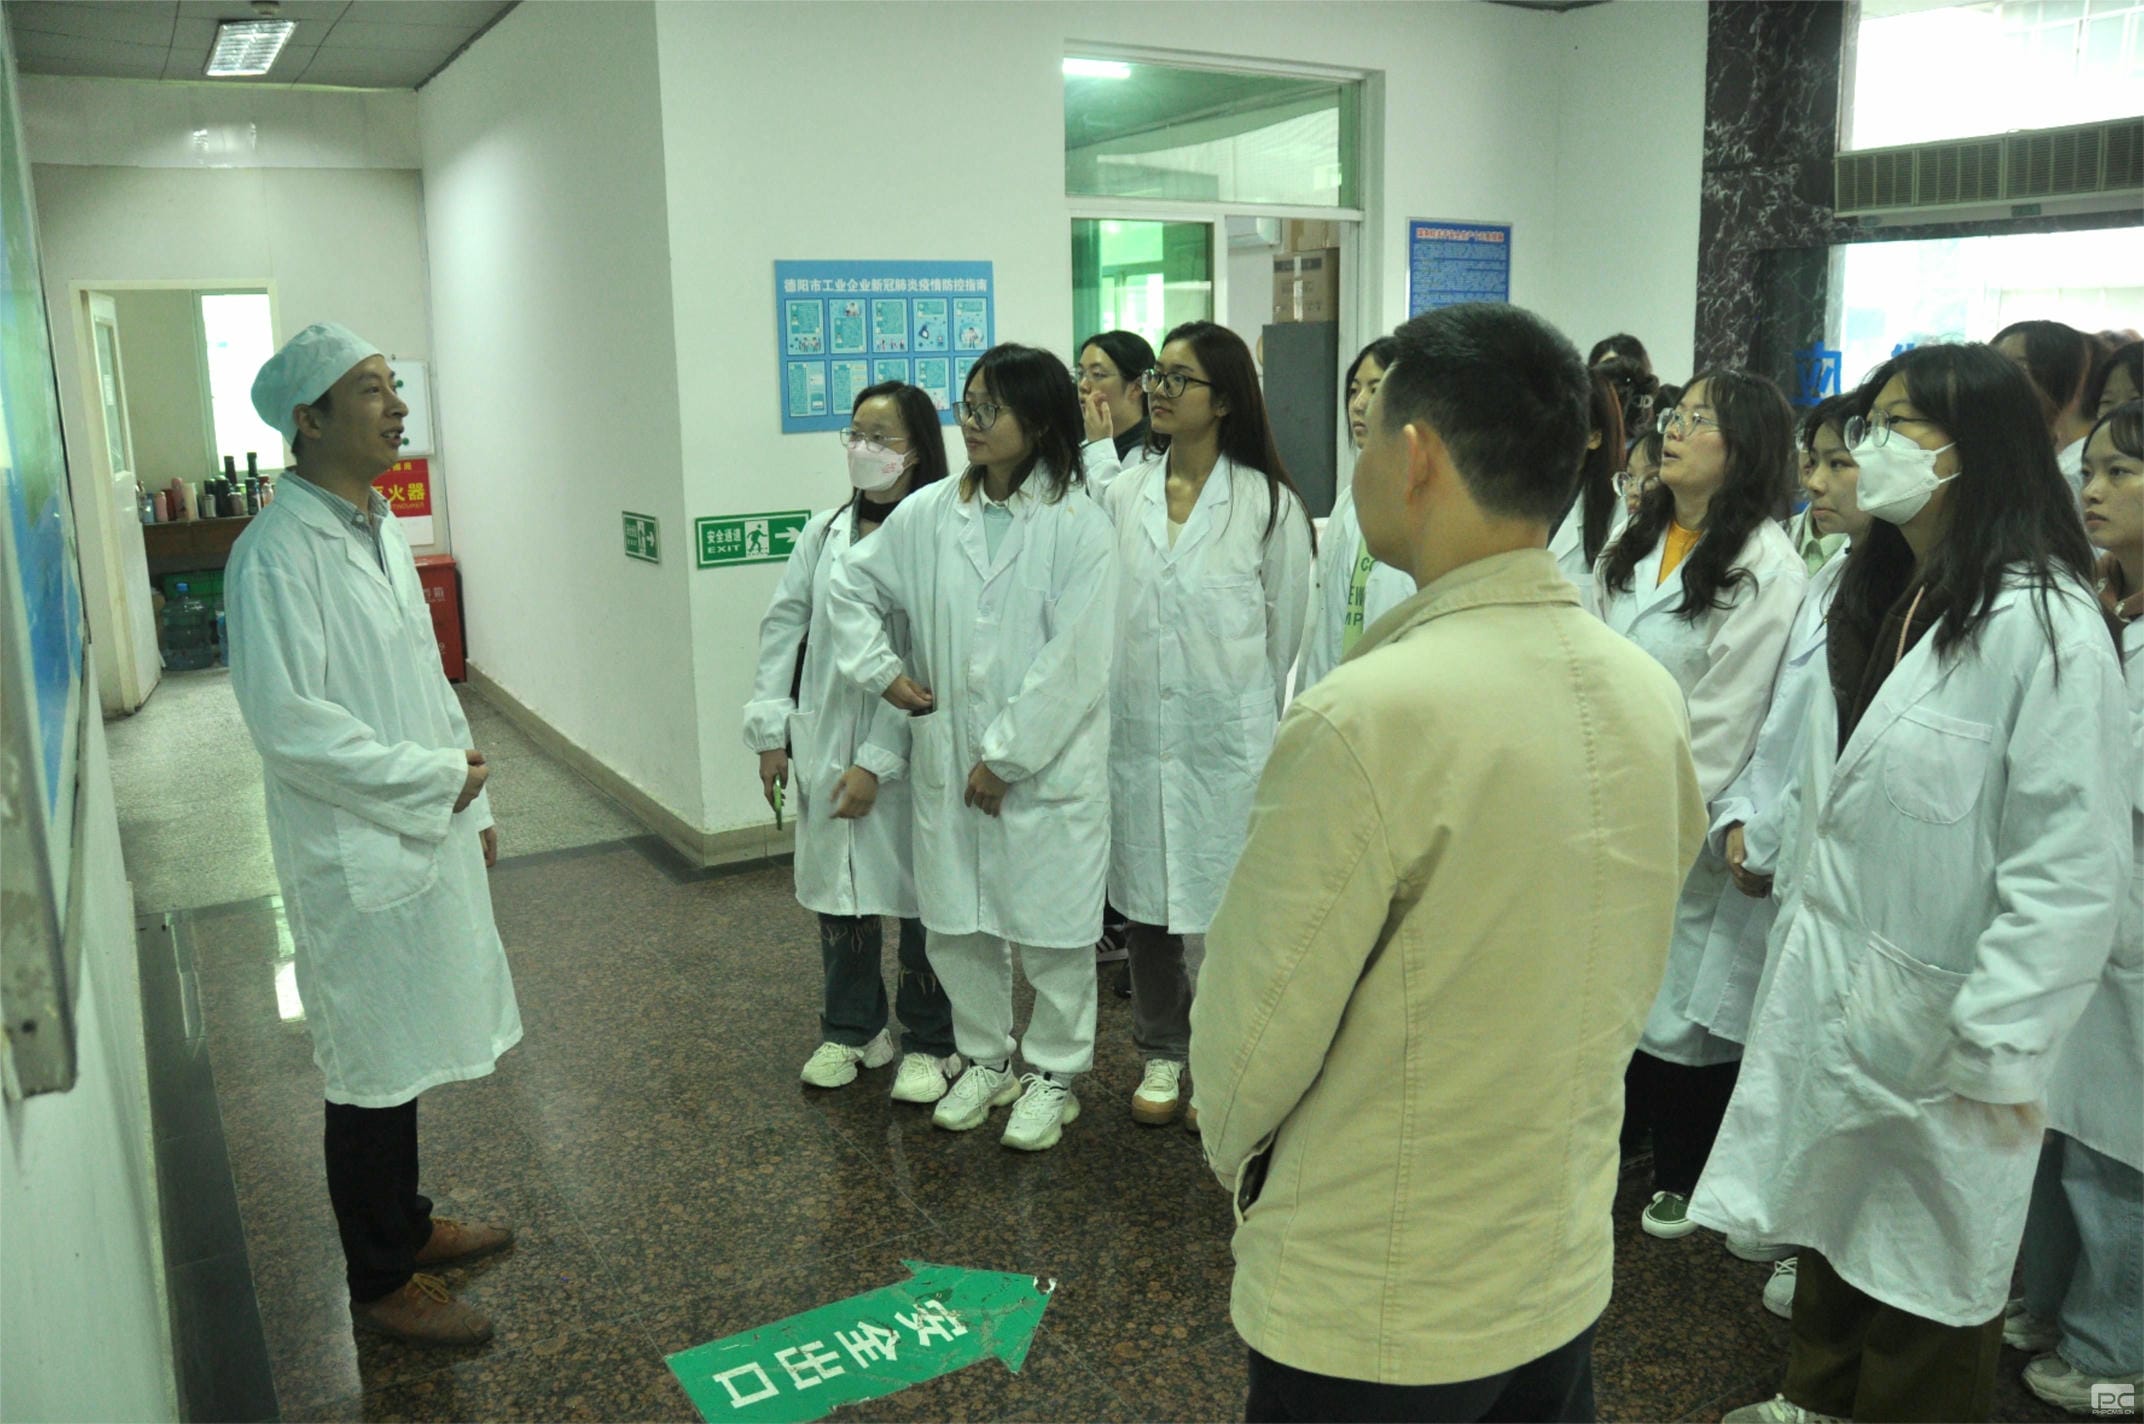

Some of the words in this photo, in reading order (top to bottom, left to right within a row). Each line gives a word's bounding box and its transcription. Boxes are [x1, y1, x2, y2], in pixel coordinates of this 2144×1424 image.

[707, 528, 741, 544] 安全通道
[708, 544, 740, 554] EXIT
[712, 1300, 969, 1409] 安全出口
